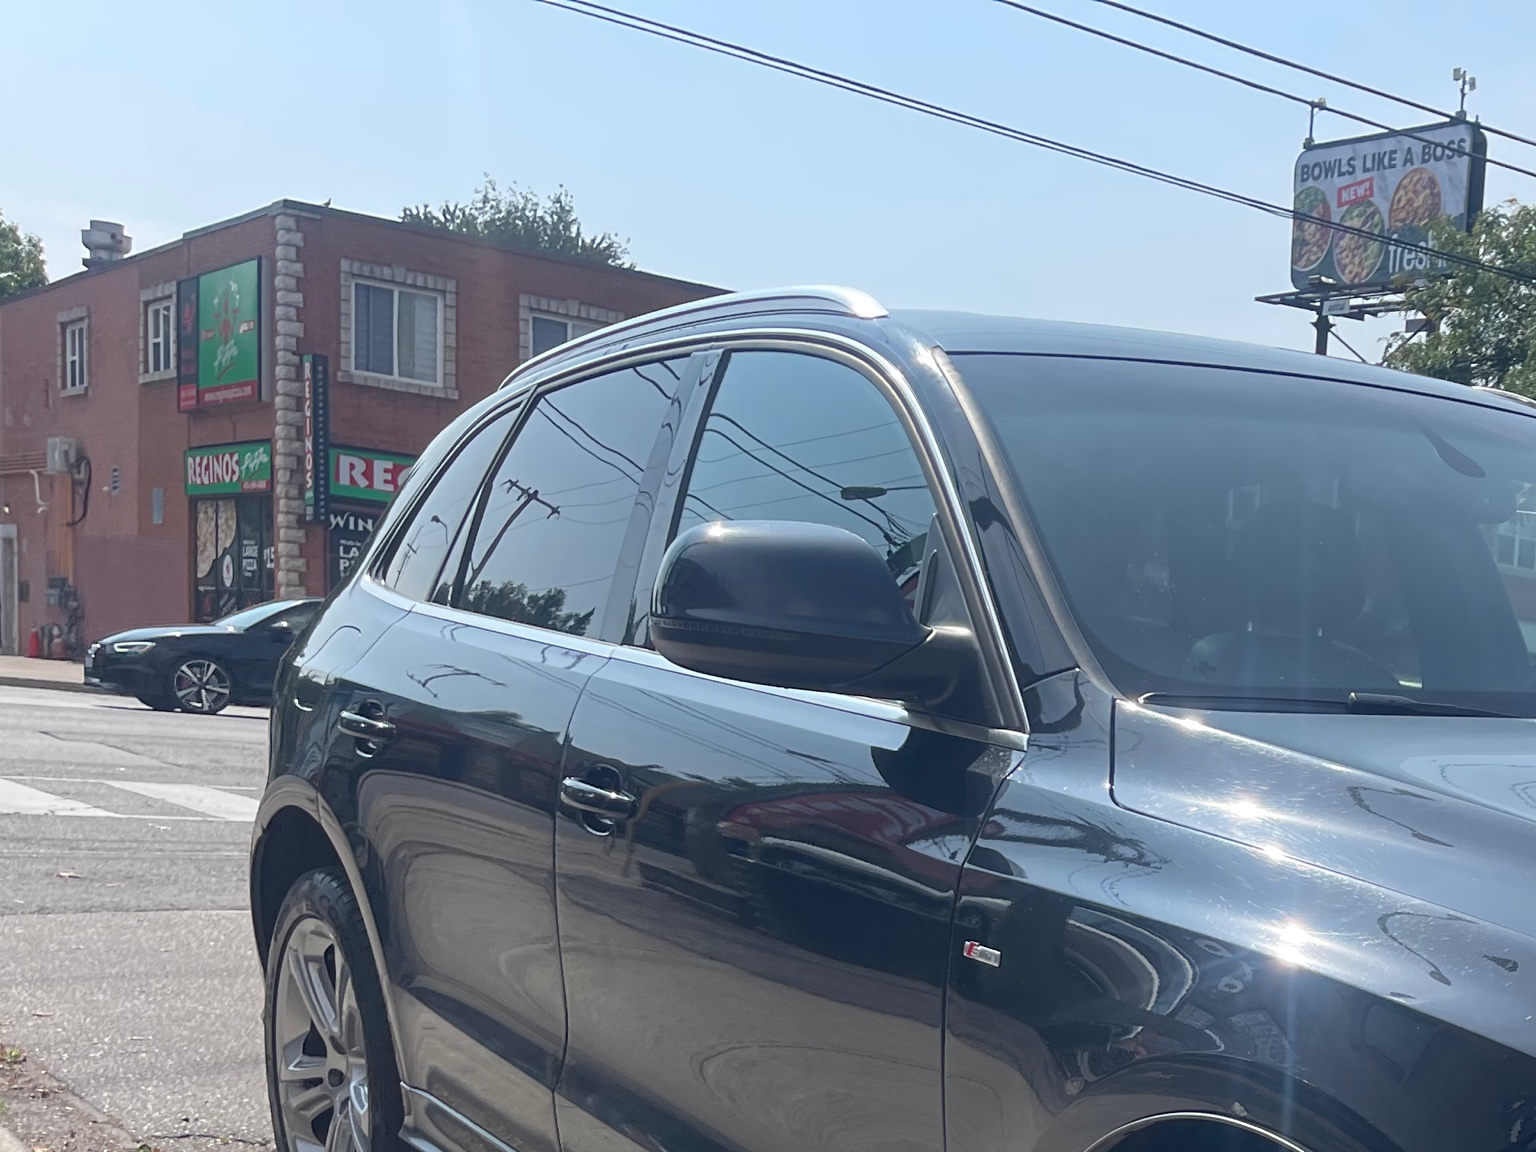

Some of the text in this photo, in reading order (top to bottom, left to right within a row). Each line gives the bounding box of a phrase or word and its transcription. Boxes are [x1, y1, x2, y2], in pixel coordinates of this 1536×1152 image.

[1301, 137, 1467, 183] BOWLS LIKE A BOSS
[1342, 182, 1370, 202] NEW!
[304, 362, 313, 489] REGINOS
[187, 453, 240, 485] REGINOS
